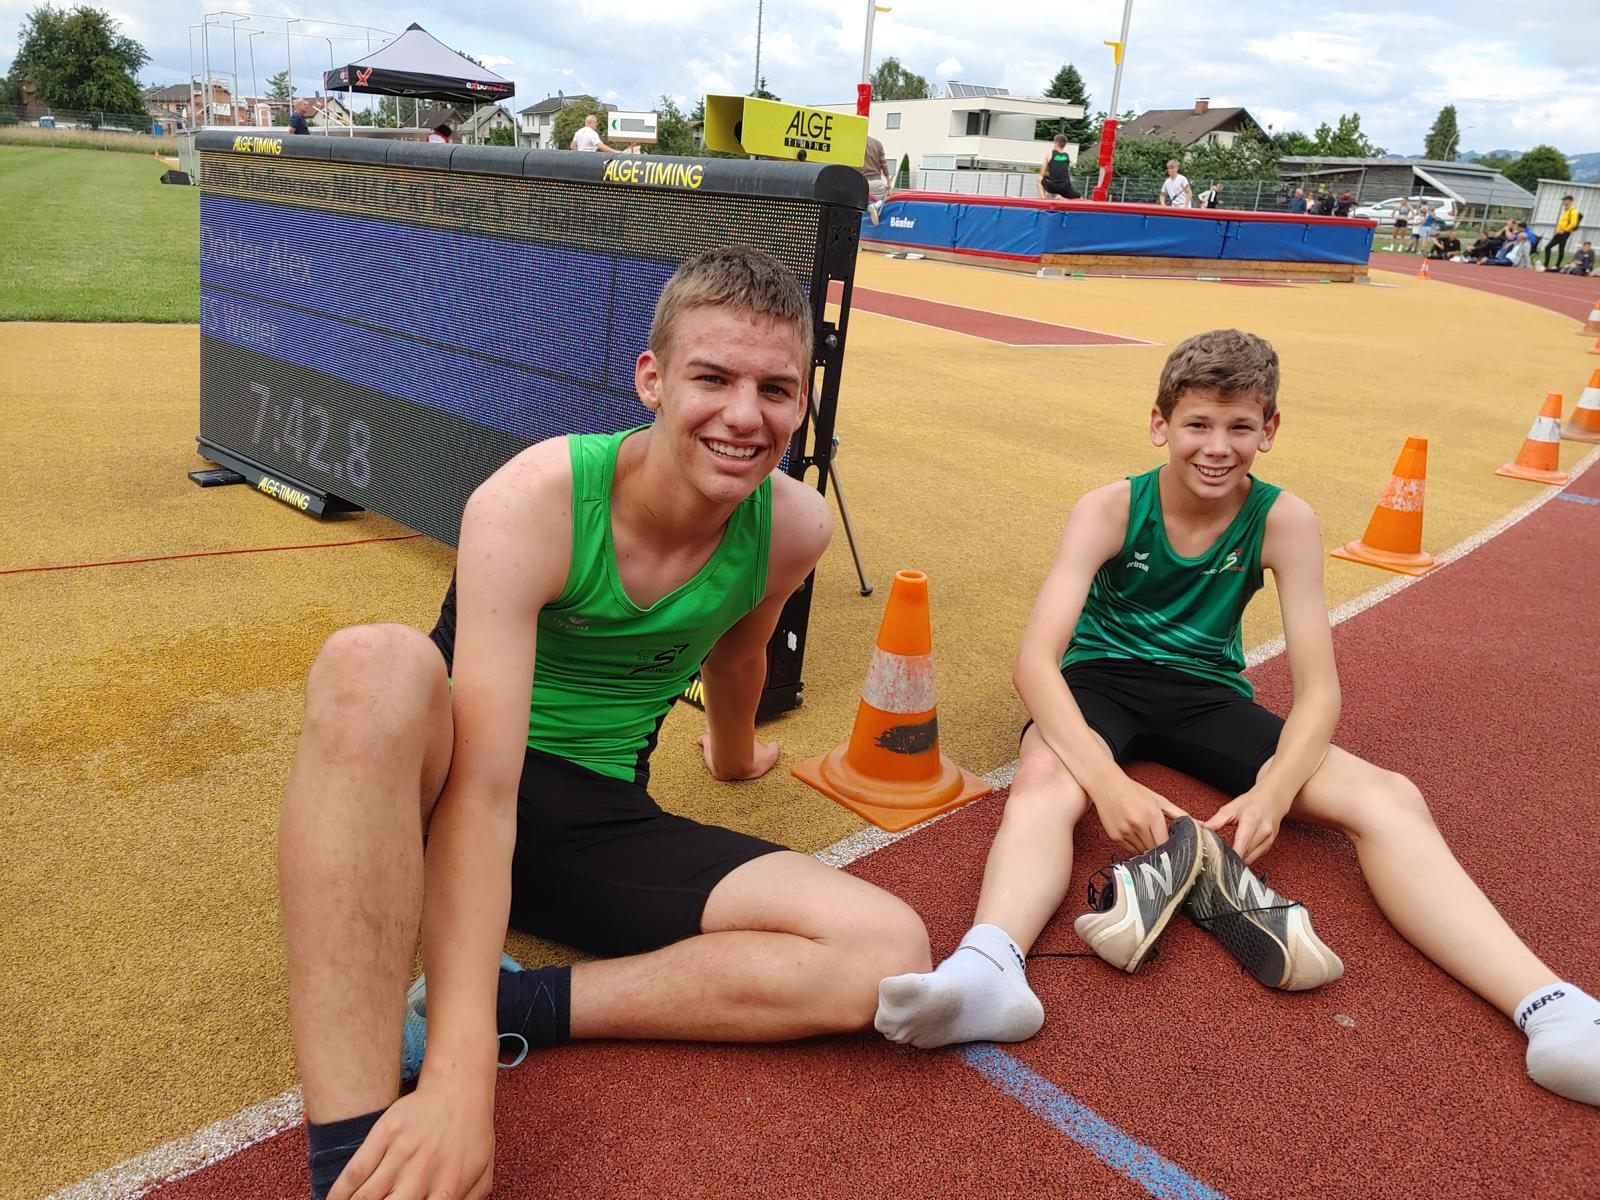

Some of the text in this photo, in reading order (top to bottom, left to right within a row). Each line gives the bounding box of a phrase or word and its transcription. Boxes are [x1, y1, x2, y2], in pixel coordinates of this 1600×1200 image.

[785, 110, 833, 141] ALGE
[233, 136, 282, 155] ALGE-TIMING
[784, 138, 831, 152] TIMING
[602, 158, 703, 190] ALGE-TIMING
[201, 225, 316, 284] Dobler Alex
[223, 302, 279, 349] Weiler
[249, 381, 372, 489] 7:42.8
[257, 476, 310, 511] ALGE-TIMING
